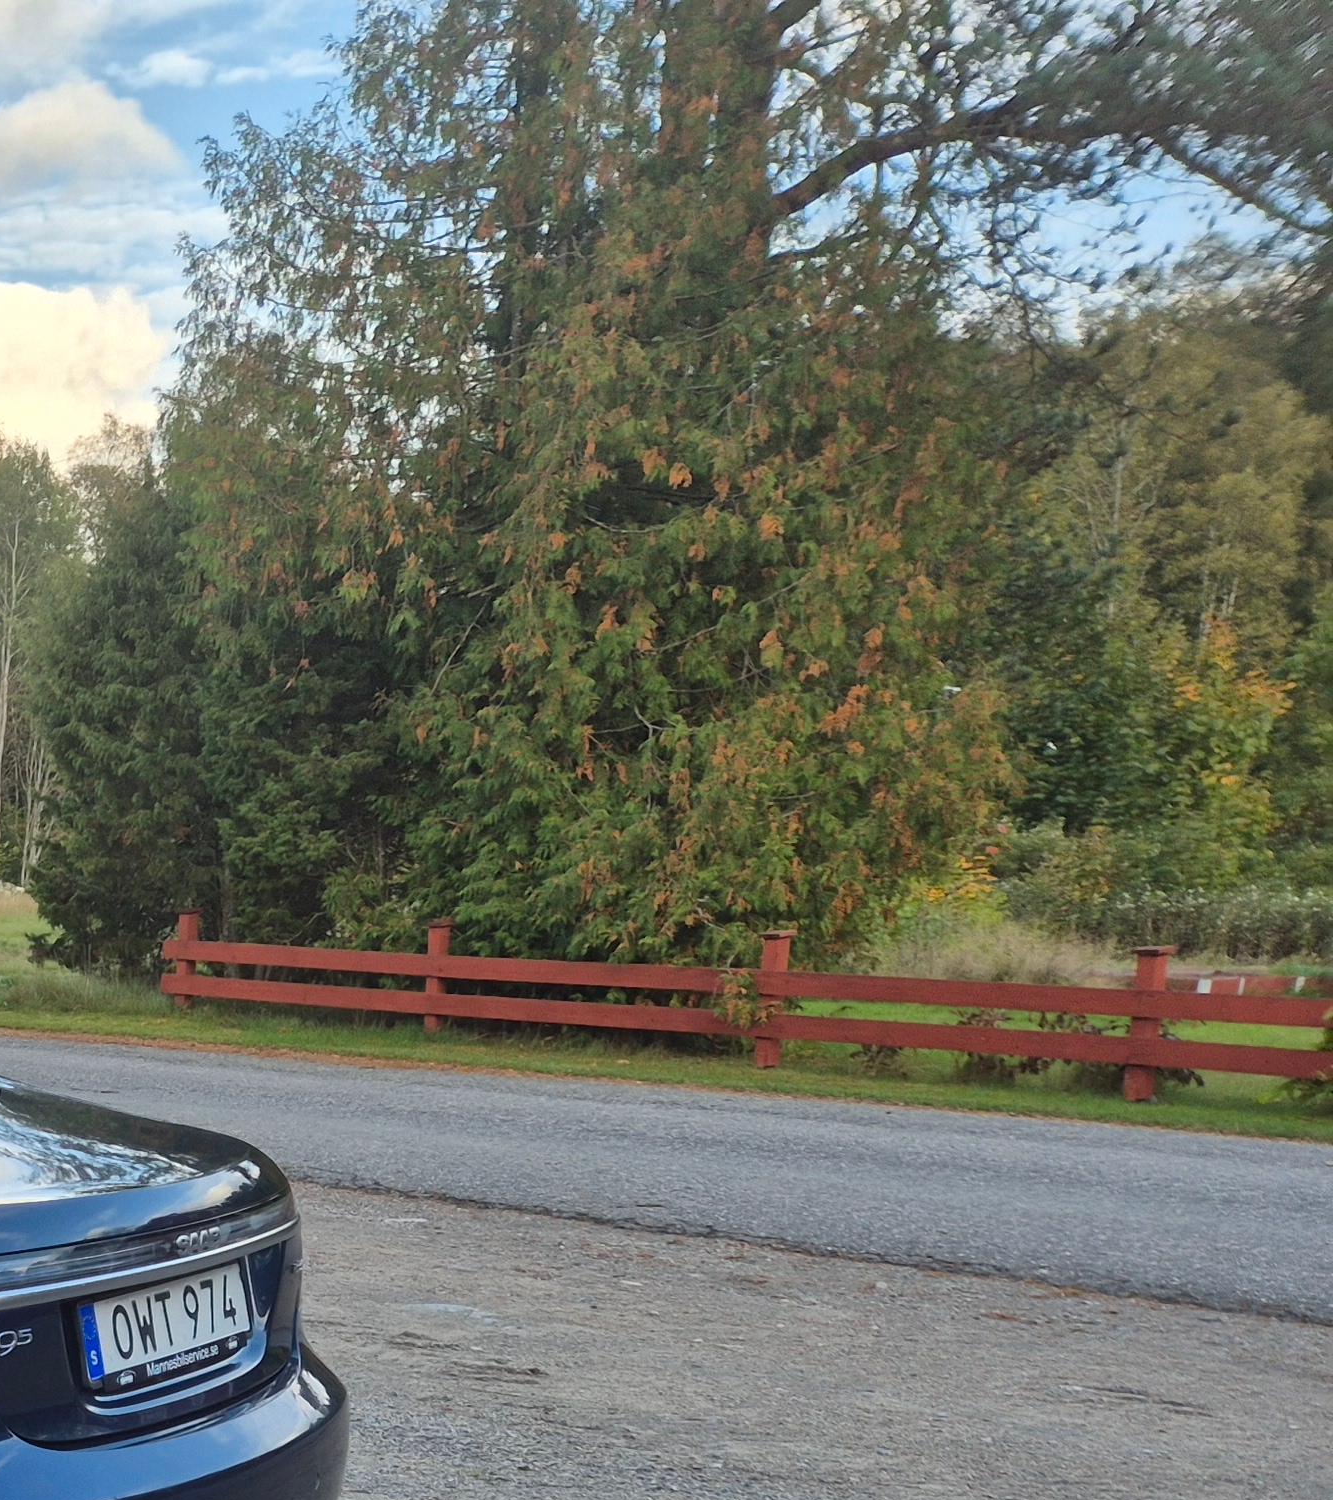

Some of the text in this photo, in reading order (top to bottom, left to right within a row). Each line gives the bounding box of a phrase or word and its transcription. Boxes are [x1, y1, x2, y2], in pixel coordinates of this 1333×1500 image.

[175, 1226, 222, 1256] SAAB
[111, 1274, 237, 1360] OWT 974
[90, 1350, 99, 1366] S
[146, 1344, 219, 1377] Mannesbilservice.se
